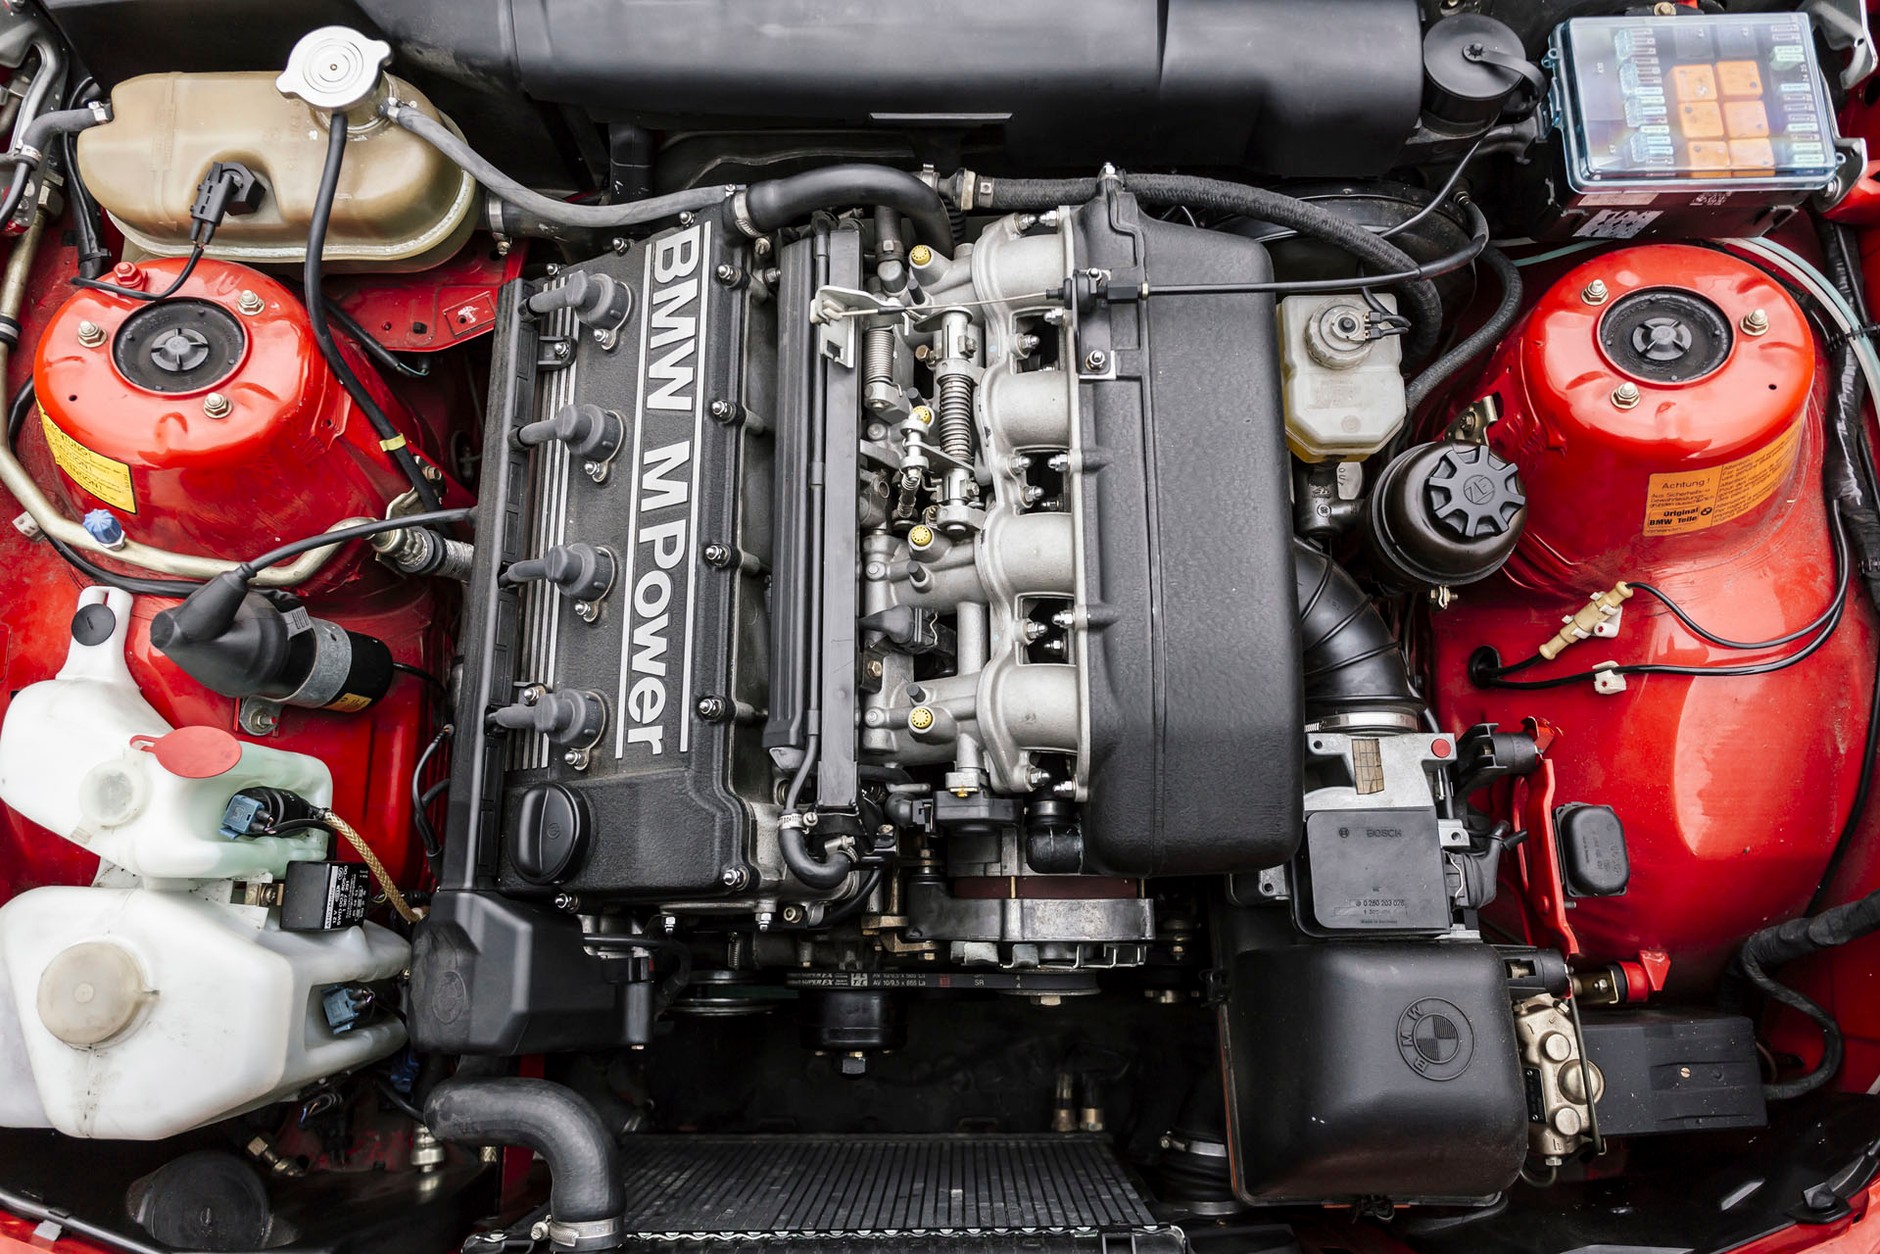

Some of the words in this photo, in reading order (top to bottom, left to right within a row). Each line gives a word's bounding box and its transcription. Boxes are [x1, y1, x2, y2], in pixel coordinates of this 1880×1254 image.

[647, 225, 700, 410] BMW
[1663, 507, 1699, 517] Original
[1649, 518, 1673, 526] BMW
[1677, 515, 1698, 523] Teile
[1365, 829, 1402, 838] BOSCH
